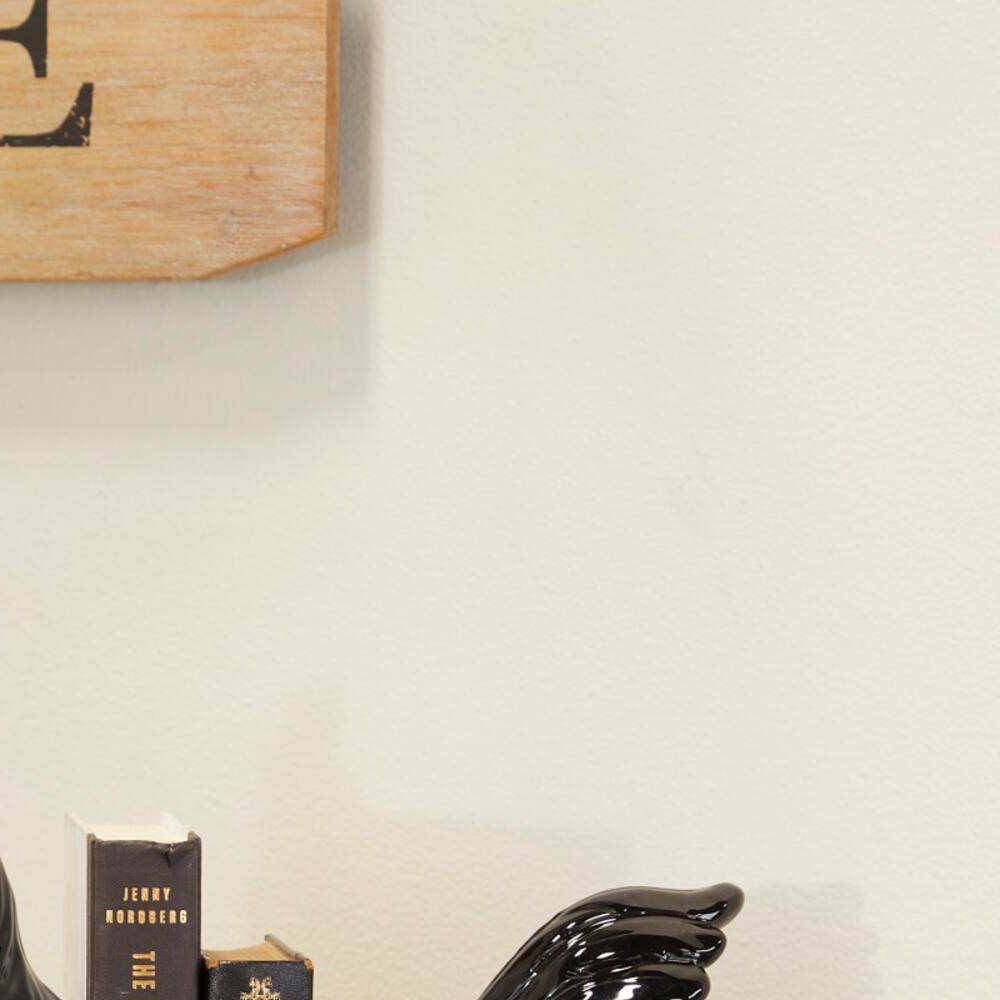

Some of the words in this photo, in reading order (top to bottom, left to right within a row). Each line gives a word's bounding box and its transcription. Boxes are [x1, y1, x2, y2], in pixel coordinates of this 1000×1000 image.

[123, 887, 171, 902] JENNY
[105, 909, 188, 925] NORDBERG
[131, 950, 156, 990] THE
